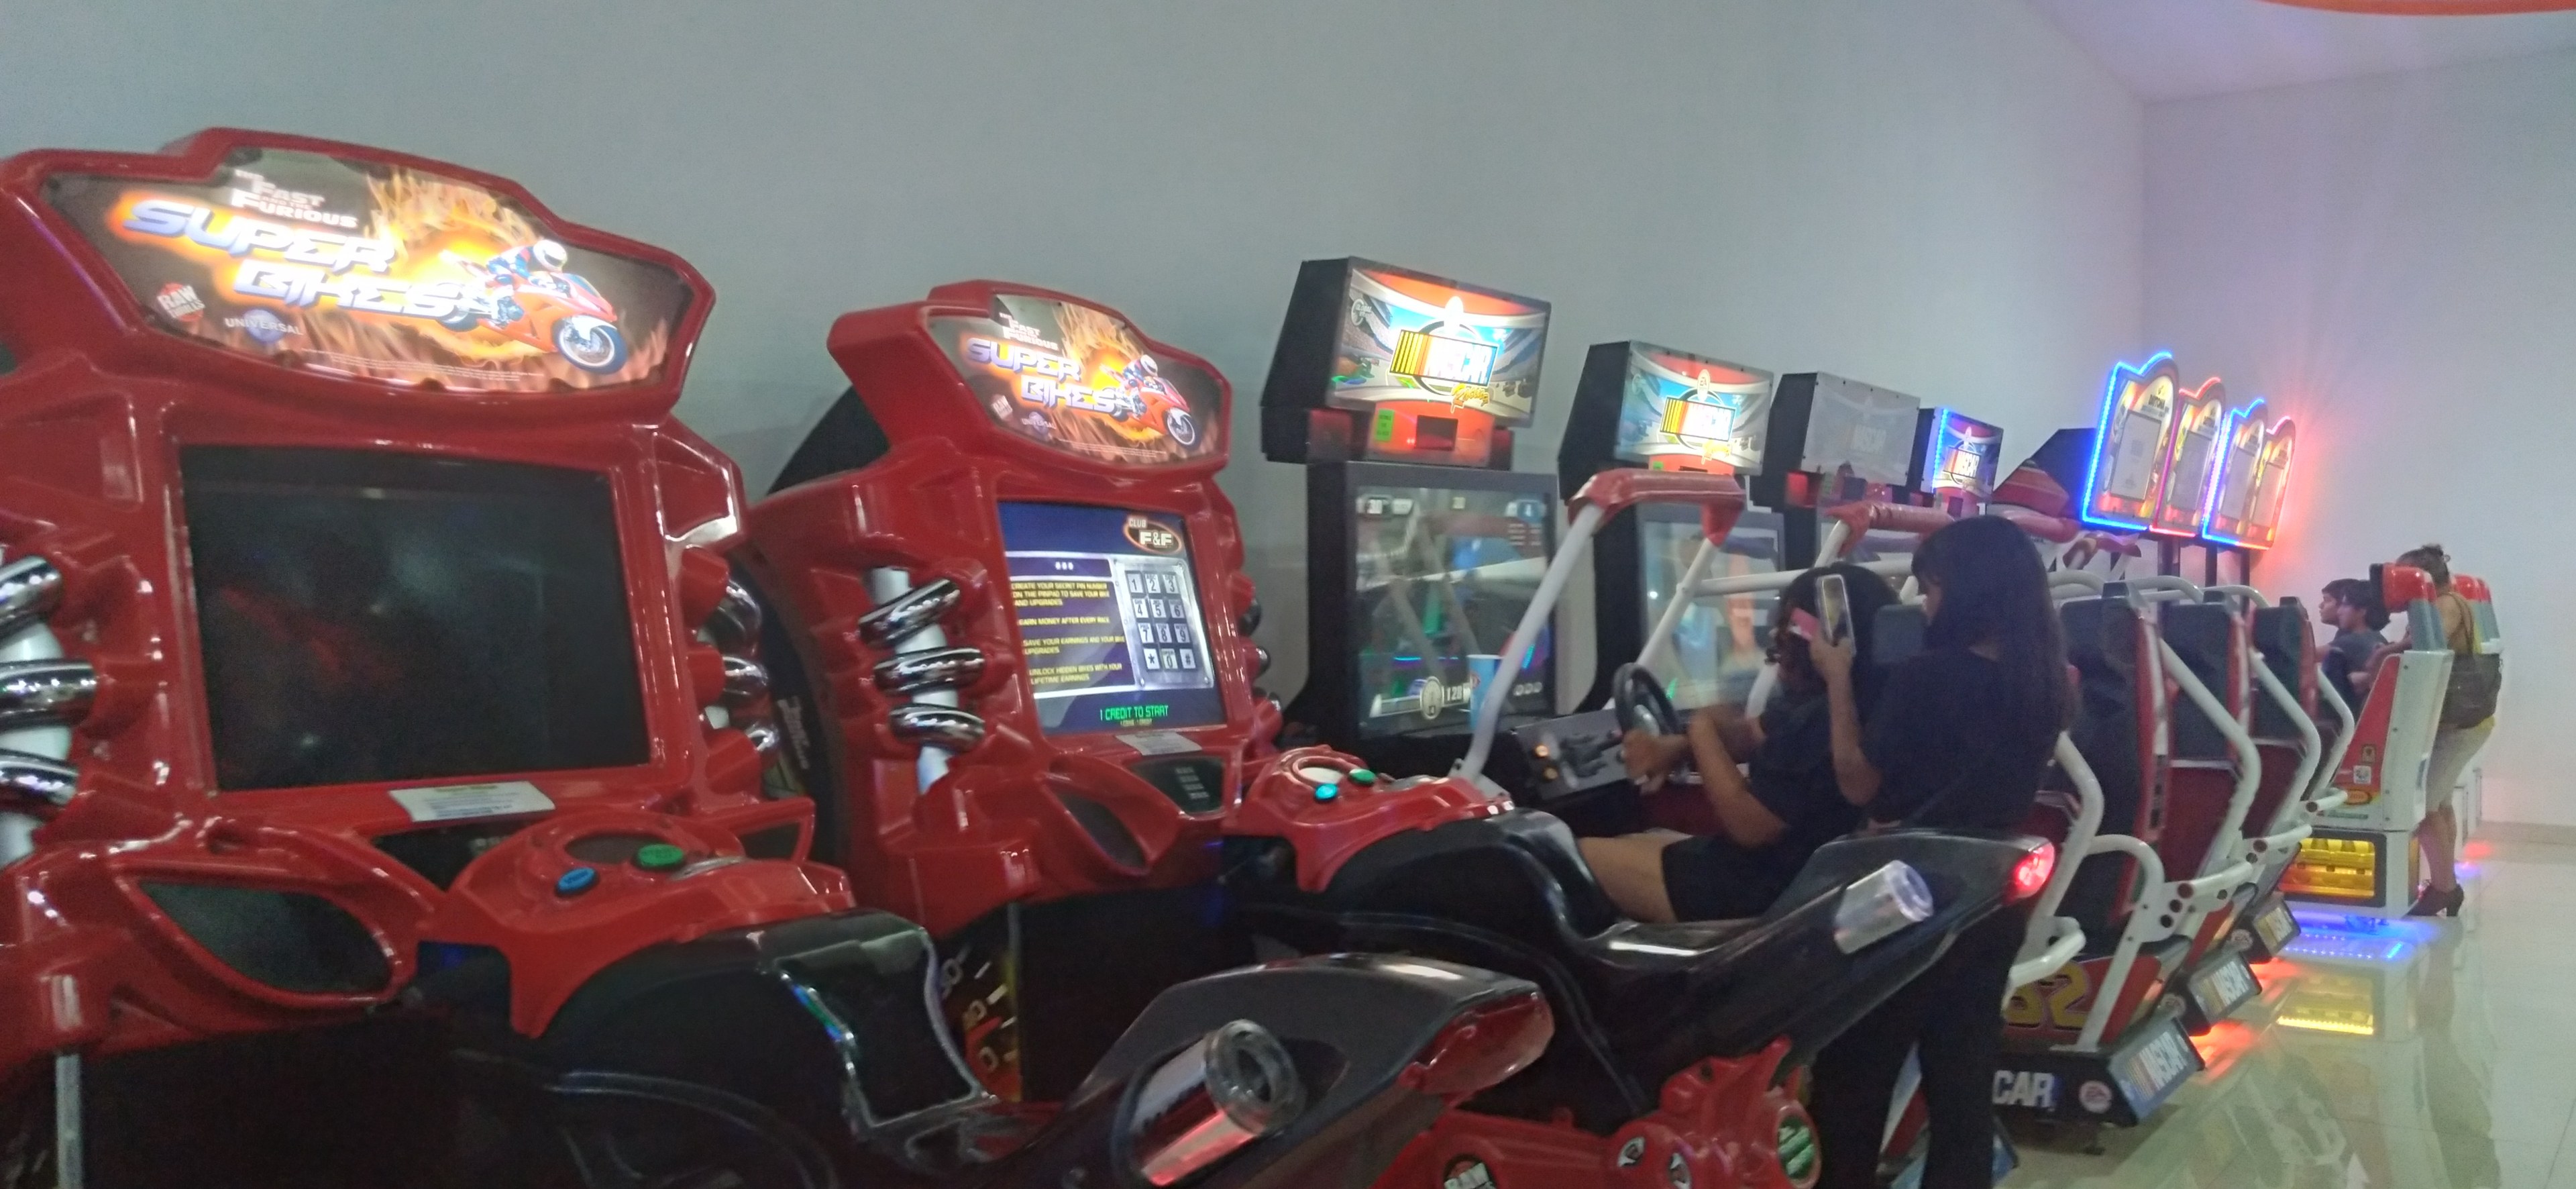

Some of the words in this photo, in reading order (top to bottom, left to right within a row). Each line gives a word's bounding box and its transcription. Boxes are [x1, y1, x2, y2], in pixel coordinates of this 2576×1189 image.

[253, 180, 325, 207] FAST
[231, 188, 359, 228] FURIOUS
[124, 199, 397, 276] SUPER
[233, 258, 465, 319] BIKES
[157, 285, 198, 310] RAW
[224, 317, 304, 336] UNIVERSAL
[966, 338, 1083, 384] SUPER
[1020, 374, 1119, 415] BIKES
[1128, 518, 1147, 528] CLUB
[1140, 530, 1172, 546] F&F
[1132, 578, 1138, 591] 1
[1149, 578, 1157, 591] 2
[1168, 579, 1175, 592] 3
[1137, 605, 1143, 615] 4
[1155, 605, 1162, 617] 5
[1174, 605, 1181, 617] 6
[1142, 629, 1148, 641] 7
[1161, 630, 1167, 642] 8
[1179, 629, 1185, 642] 9
[1042, 638, 1060, 646] YOUR
[1167, 656, 1173, 668] 0
[1030, 675, 1060, 685] LIFETIME
[1105, 707, 1132, 721] CREDIT
[1134, 706, 1144, 718] TO
[1145, 705, 1169, 718] START
[1992, 1070, 2056, 1108] CAR
